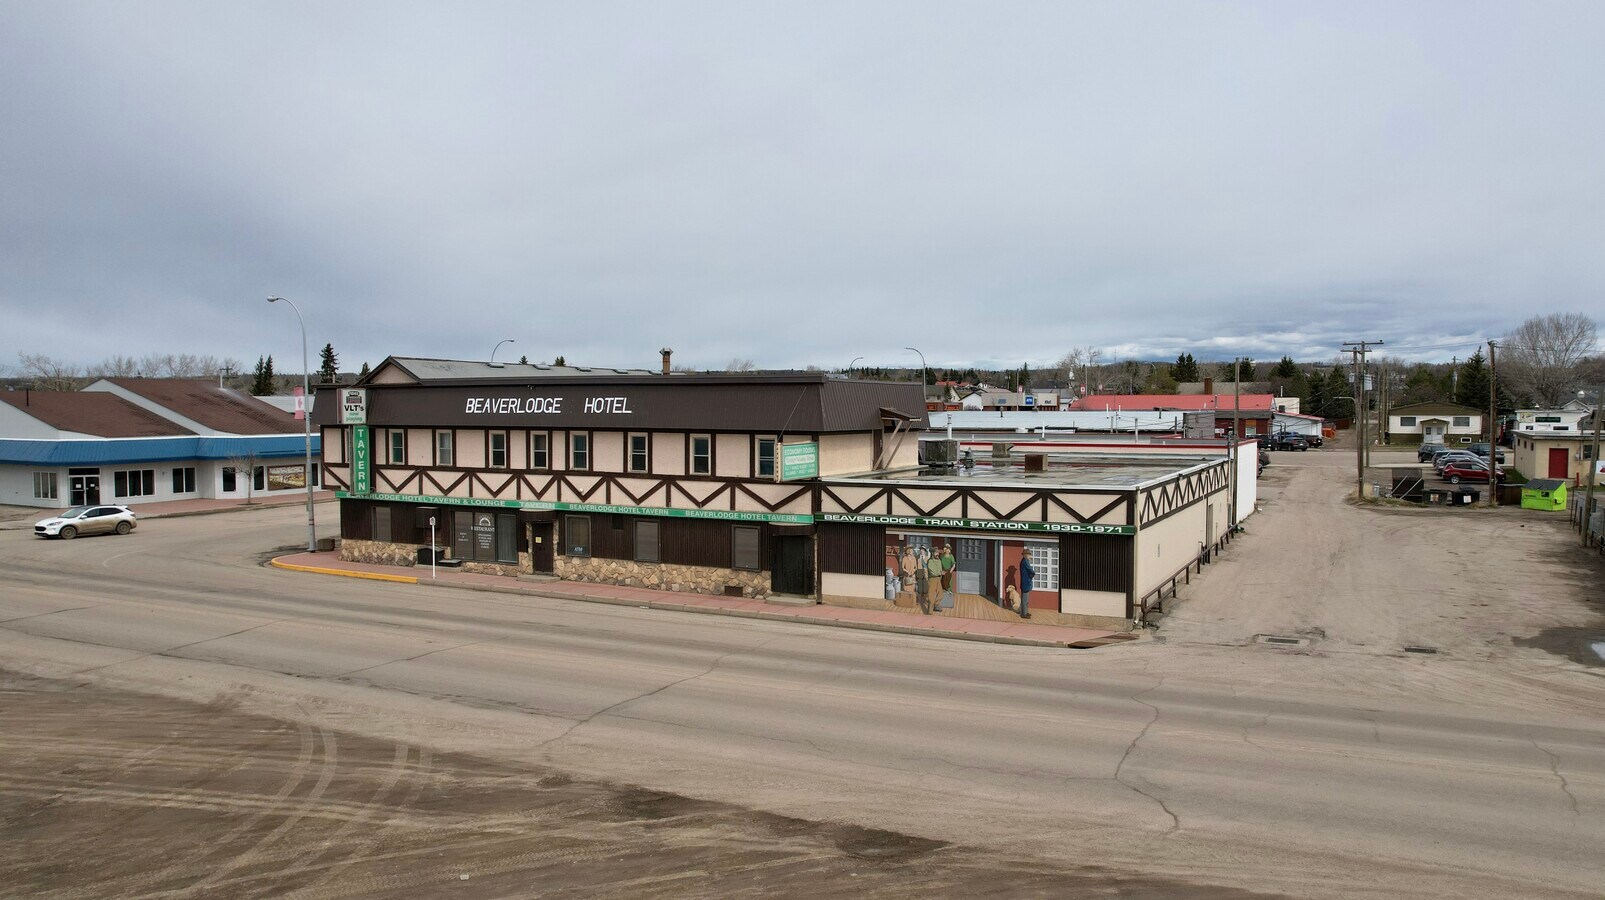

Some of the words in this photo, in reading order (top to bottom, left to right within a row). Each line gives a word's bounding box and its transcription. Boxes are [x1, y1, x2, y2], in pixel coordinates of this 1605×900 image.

[465, 397, 563, 414] BEAVERLODGE
[584, 397, 632, 414] HOTEL
[357, 428, 366, 491] TAVERN
[470, 499, 506, 507] LOUNGE
[519, 501, 556, 509] TAVERN
[569, 503, 617, 513] BEAVERLODGE
[618, 506, 640, 514] HOTEL
[641, 507, 669, 516] TAVERN
[685, 510, 739, 519] BEAVERLODGE
[740, 512, 765, 520] HOTEL
[766, 513, 797, 522] TAVERN
[823, 514, 917, 525] BEAVERLODGE
[922, 518, 964, 527] TRAIN
[969, 520, 1029, 530] STATION
[1042, 523, 1123, 534] 1930-1971
